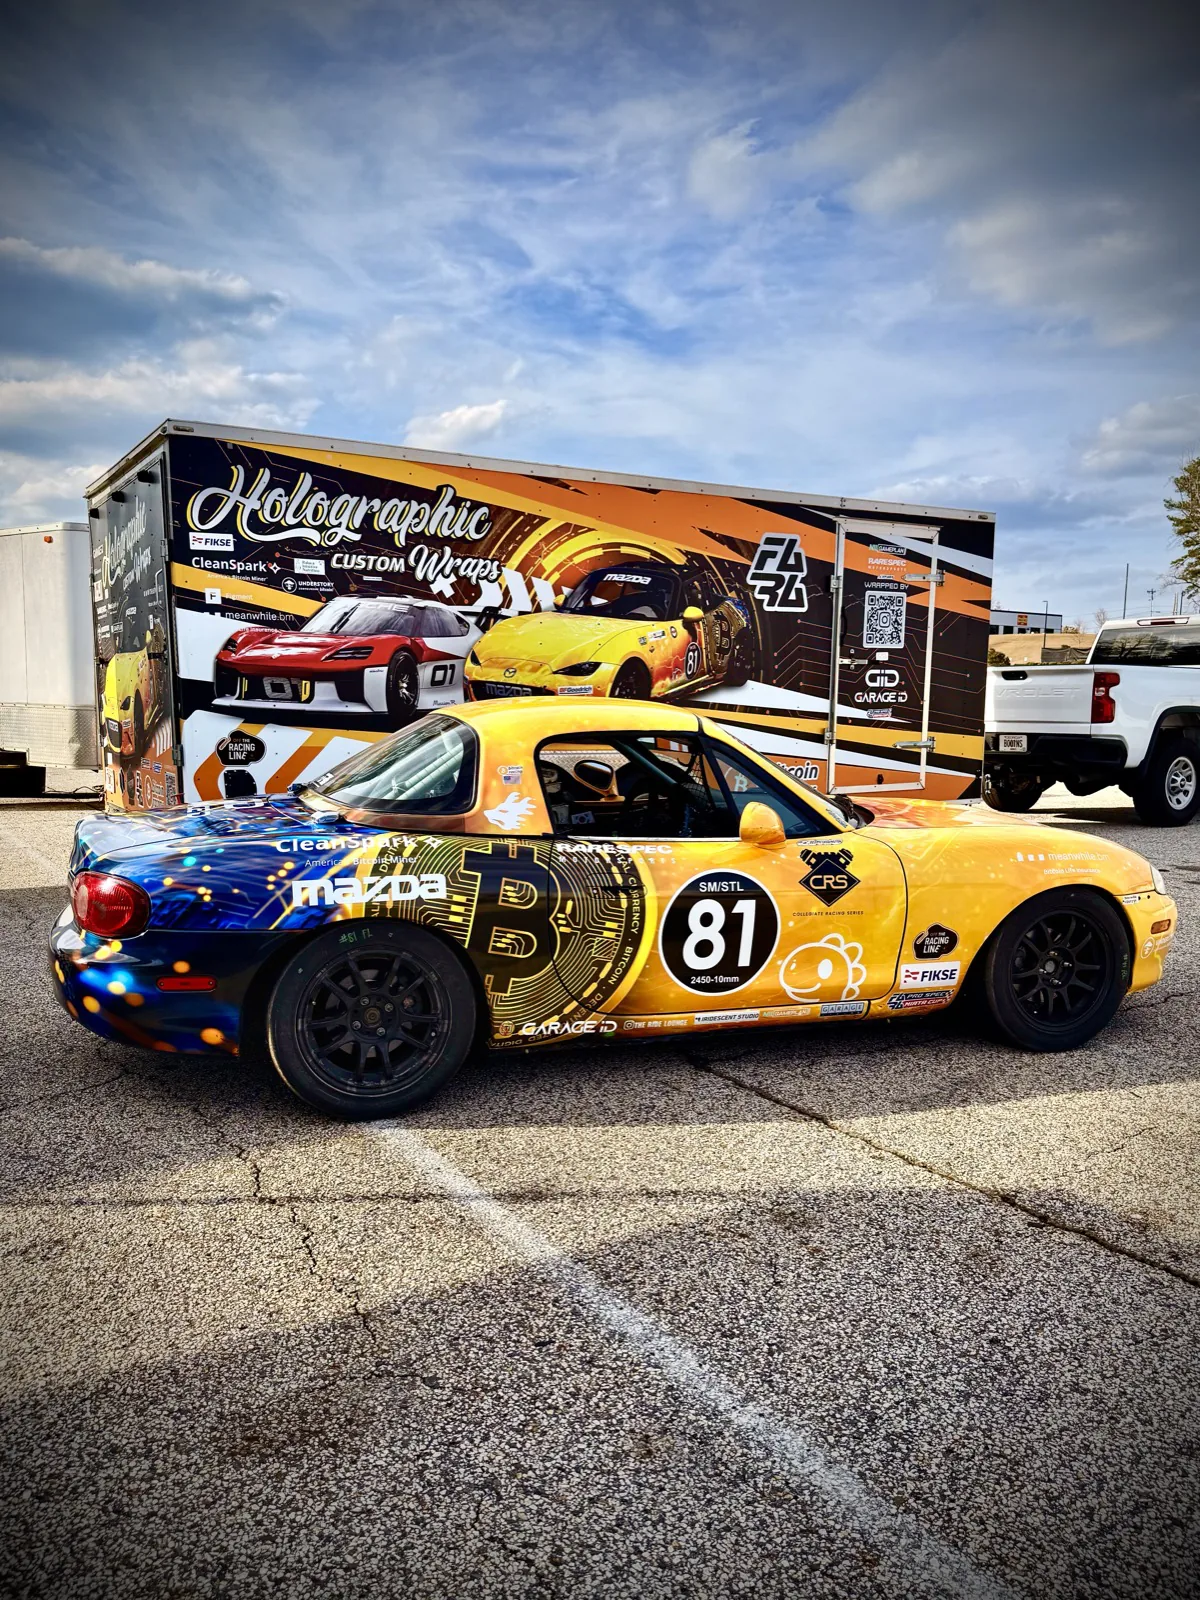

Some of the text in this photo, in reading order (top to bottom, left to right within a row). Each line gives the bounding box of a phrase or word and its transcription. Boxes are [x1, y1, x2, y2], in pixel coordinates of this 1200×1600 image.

[187, 464, 493, 547] Holographic
[204, 537, 232, 547] FIKSE
[191, 556, 267, 573] CleanSpark
[331, 552, 406, 574] CUSTOM
[407, 544, 502, 586] Wraps
[864, 581, 899, 590] WRAPPED
[225, 611, 295, 621] meanwhile.bm
[686, 650, 698, 675] 81
[430, 663, 456, 687] 01
[854, 692, 897, 703] GARAGE
[228, 743, 256, 752] RACING
[228, 752, 248, 760] LINE
[275, 835, 418, 853] CleanSpark
[555, 843, 673, 855] RARESPEC
[390, 855, 418, 864] Miner
[699, 881, 745, 893] SM/STL
[809, 874, 849, 890] CRS
[682, 898, 757, 971] 81
[924, 936, 950, 946] RACING
[923, 944, 941, 954] LINE
[607, 946, 634, 985] BITCOIN
[690, 975, 740, 985] 2450-10mm
[920, 968, 958, 982] FIKSE
[822, 1002, 864, 1014] GARAGE
[737, 1012, 760, 1021] STUDIO
[521, 1020, 598, 1036] GARAGE
